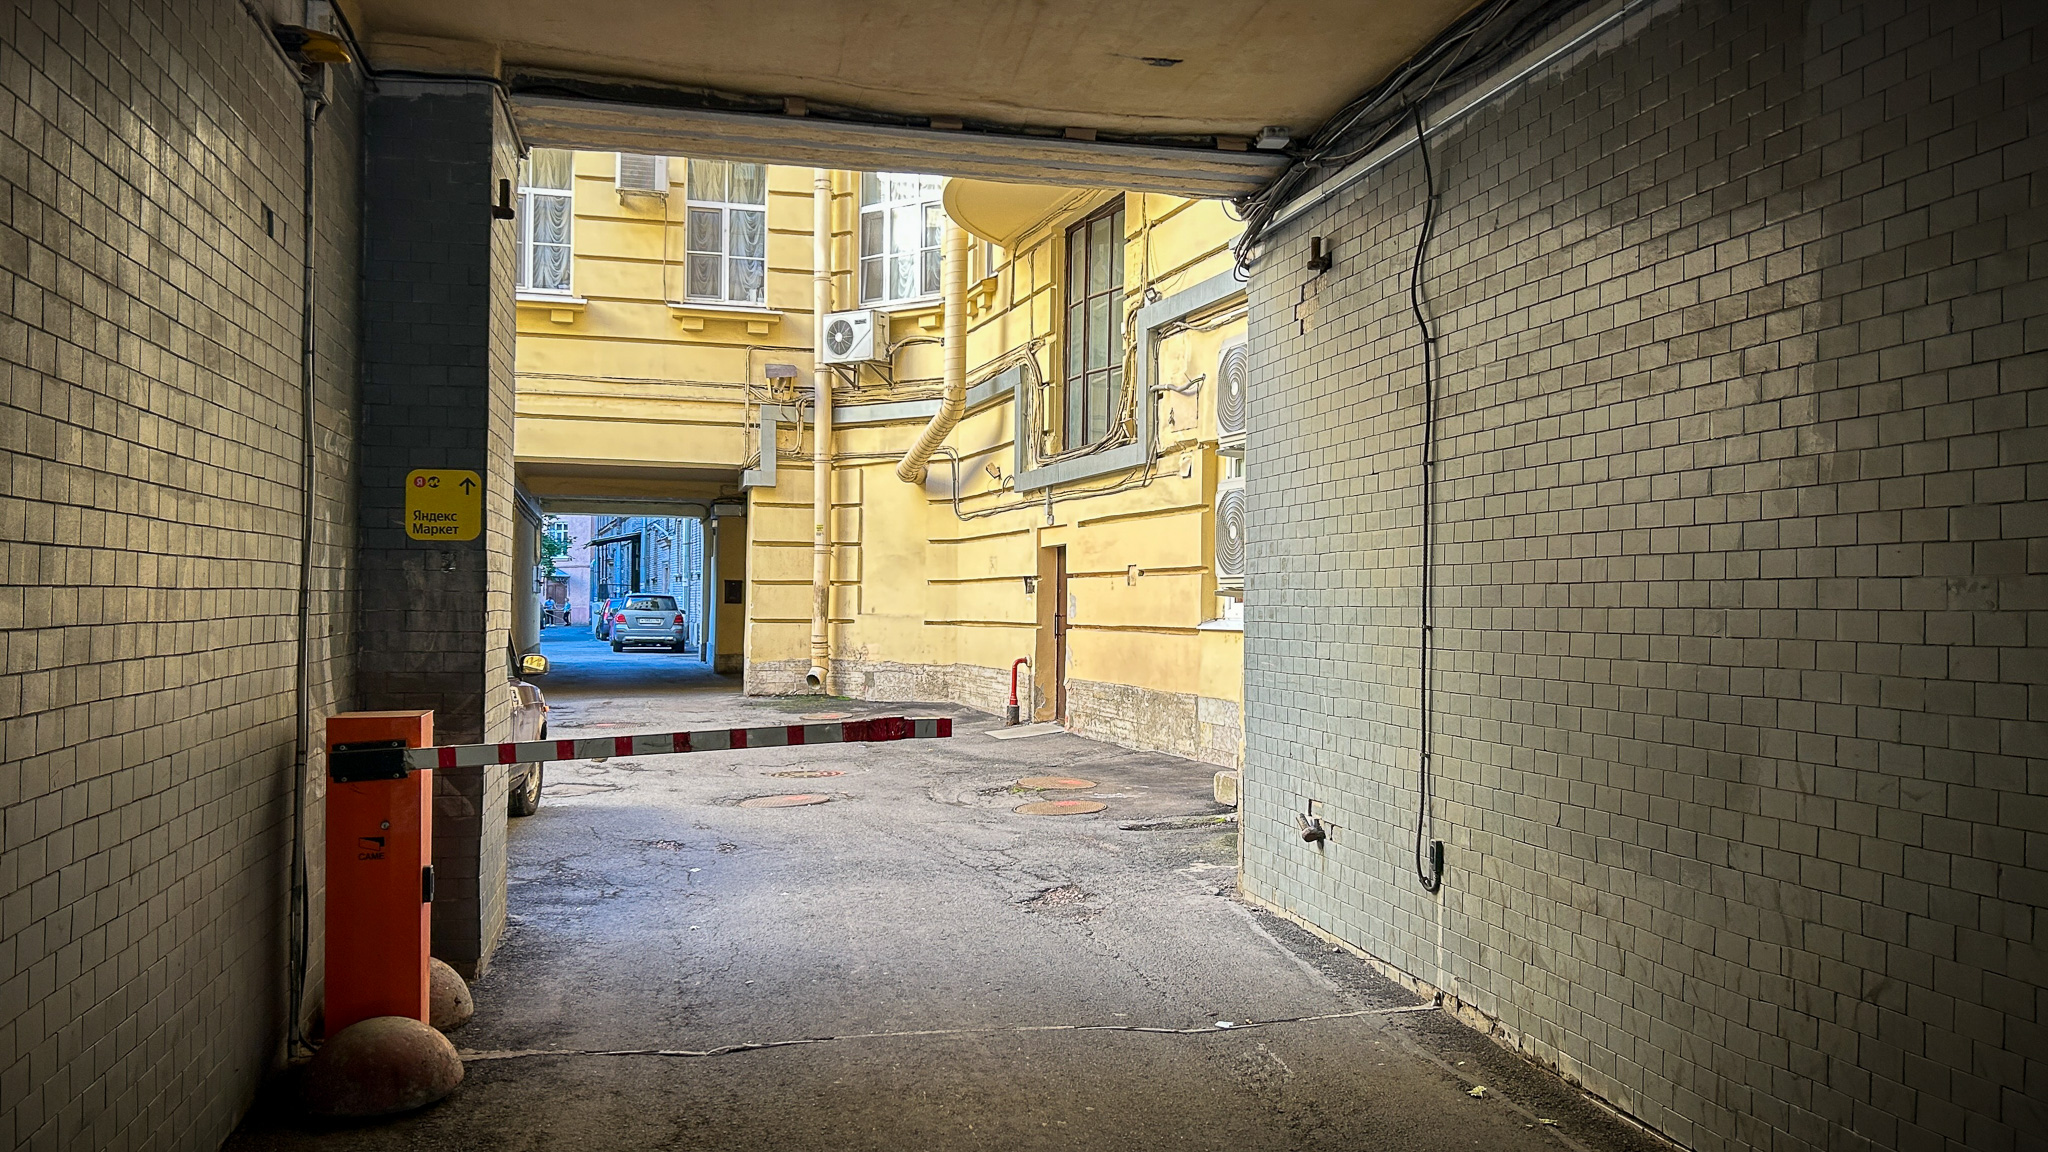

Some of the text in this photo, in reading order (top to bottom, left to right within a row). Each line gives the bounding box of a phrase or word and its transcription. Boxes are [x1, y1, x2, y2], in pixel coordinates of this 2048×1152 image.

[413, 510, 457, 522] Яндекс
[412, 523, 459, 536] Маркет
[358, 852, 385, 860] CAME
